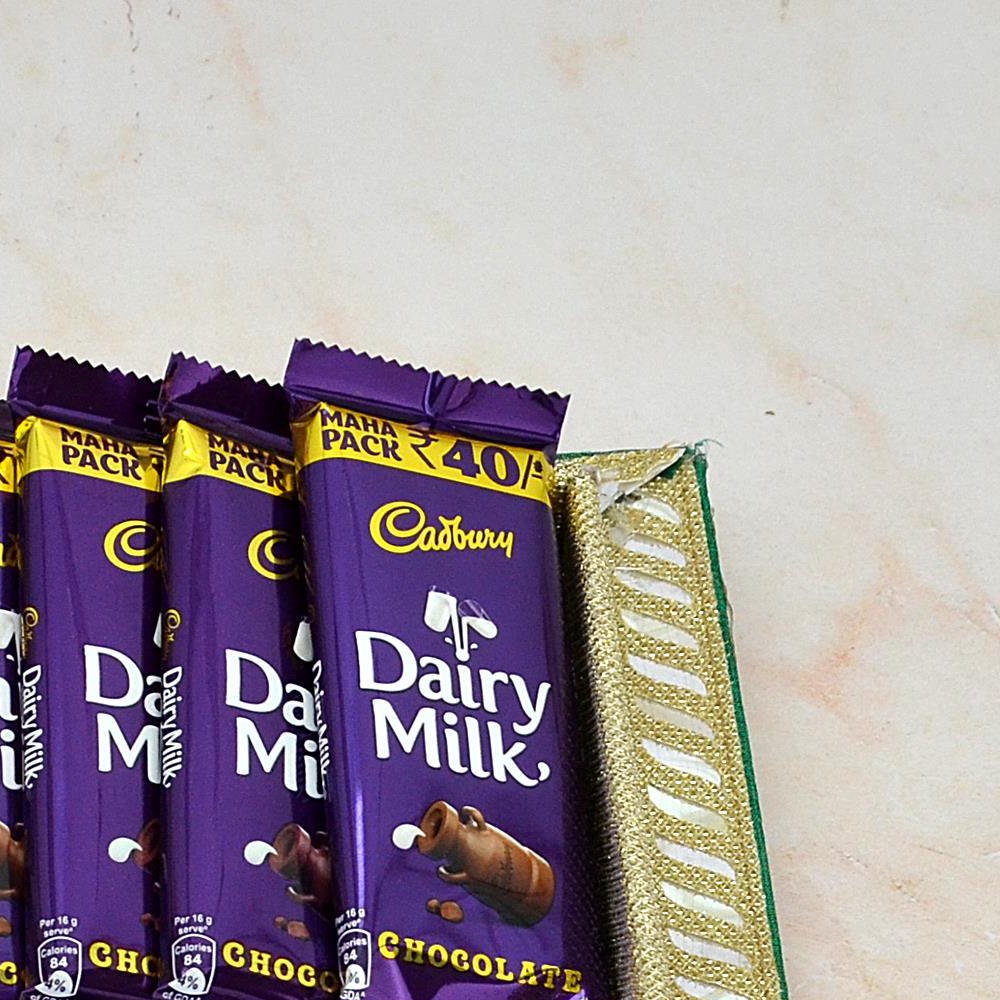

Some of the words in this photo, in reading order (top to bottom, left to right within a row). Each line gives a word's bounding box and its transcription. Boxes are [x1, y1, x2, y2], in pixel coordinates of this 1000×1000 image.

[320, 409, 397, 438] MAHA
[60, 427, 139, 458] MAHA
[322, 429, 402, 461] PACK
[62, 445, 143, 480] PACK
[209, 451, 287, 491] PACK
[369, 501, 514, 558] Cadbury
[21, 664, 42, 729] Dairy
[160, 666, 183, 730] Dairy
[355, 630, 552, 735] Dairy
[24, 728, 44, 789] Milk
[162, 729, 183, 789] Milk
[372, 699, 551, 788] Milk
[40, 918, 55, 929] Per
[57, 916, 69, 926] 16
[71, 918, 78, 928] g
[174, 916, 190, 926] Per
[192, 914, 204, 923] 16
[206, 916, 213, 926] g
[41, 945, 78, 958] Calories
[49, 956, 68, 969] 84
[175, 942, 212, 955] Calories
[183, 953, 202, 966] 84
[377, 930, 584, 993] CHOCOLATE
